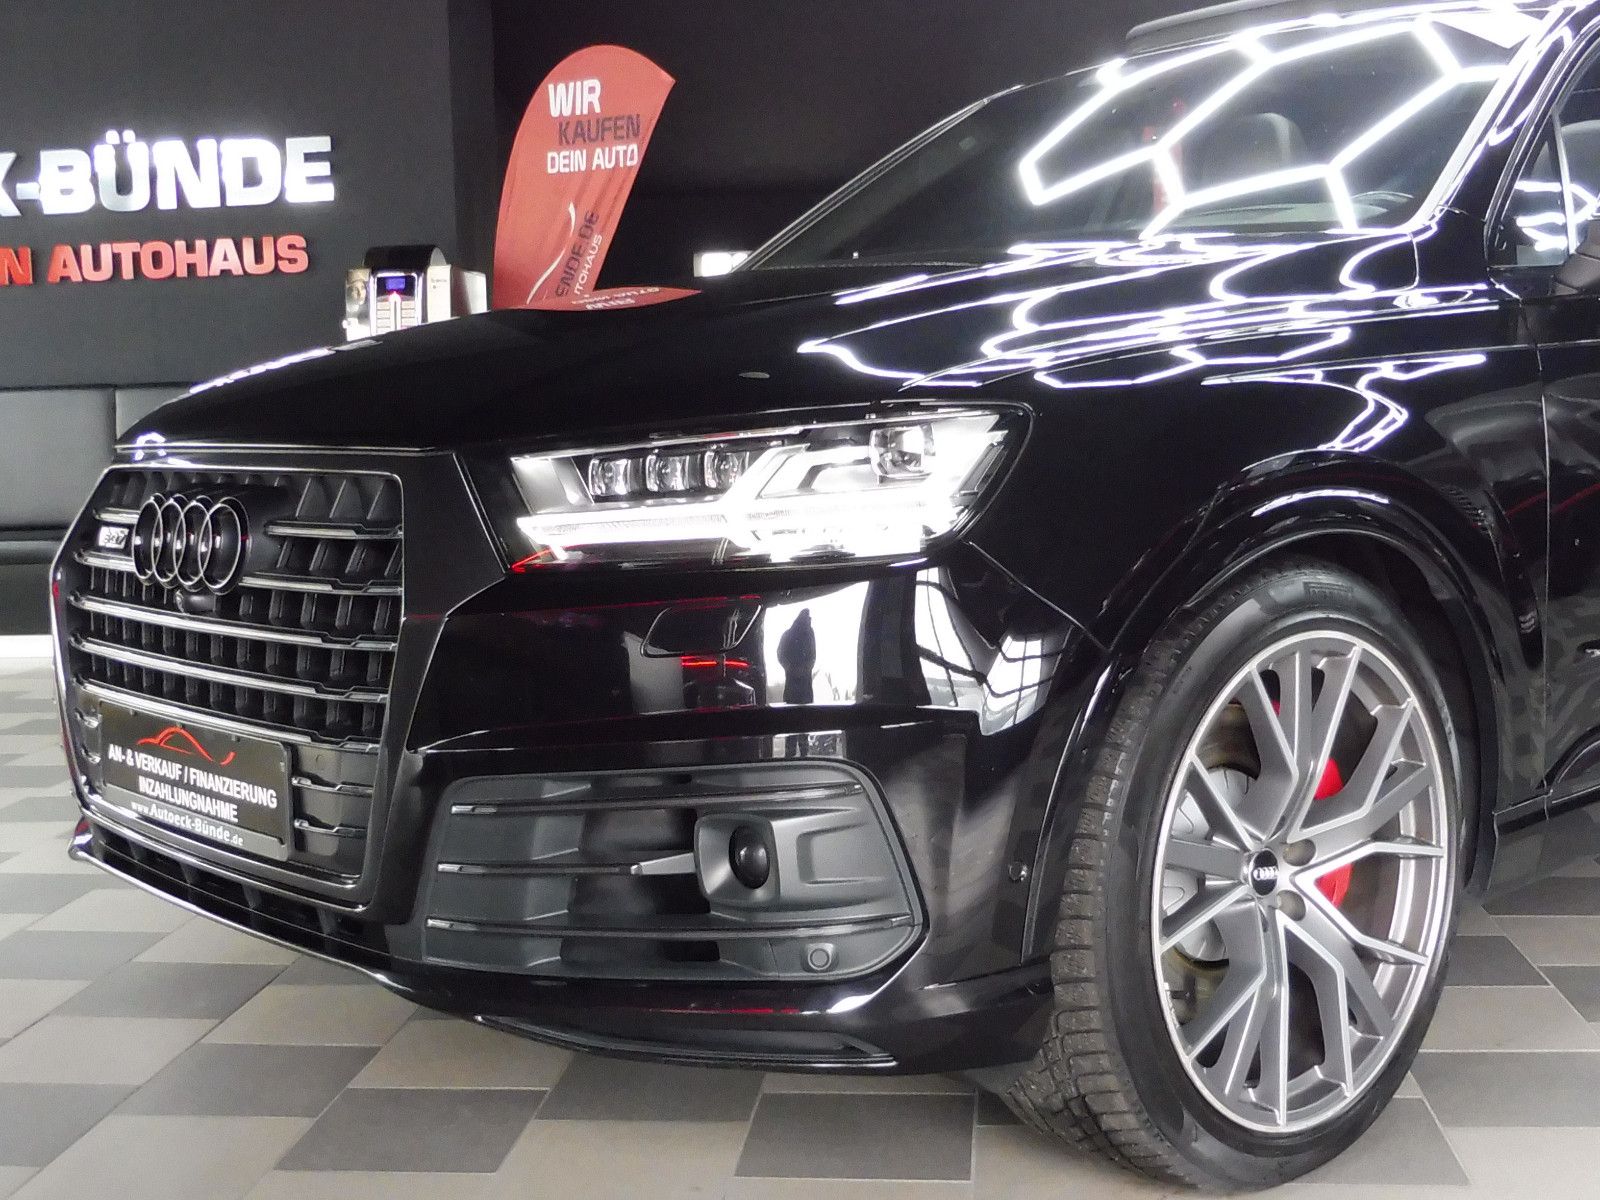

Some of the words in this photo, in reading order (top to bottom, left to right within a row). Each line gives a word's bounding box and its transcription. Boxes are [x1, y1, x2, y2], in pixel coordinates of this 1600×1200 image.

[547, 78, 602, 118] WIR
[558, 113, 641, 146] KAUFEN
[547, 150, 587, 174] DEIN
[591, 143, 639, 171] AUTO
[47, 234, 309, 283] AUTOHAUS
[126, 748, 135, 767] &
[134, 751, 182, 780] VERKAUF
[189, 767, 278, 809] FINANZIERUNG
[138, 774, 239, 823] INZAHLUNGNAHME
